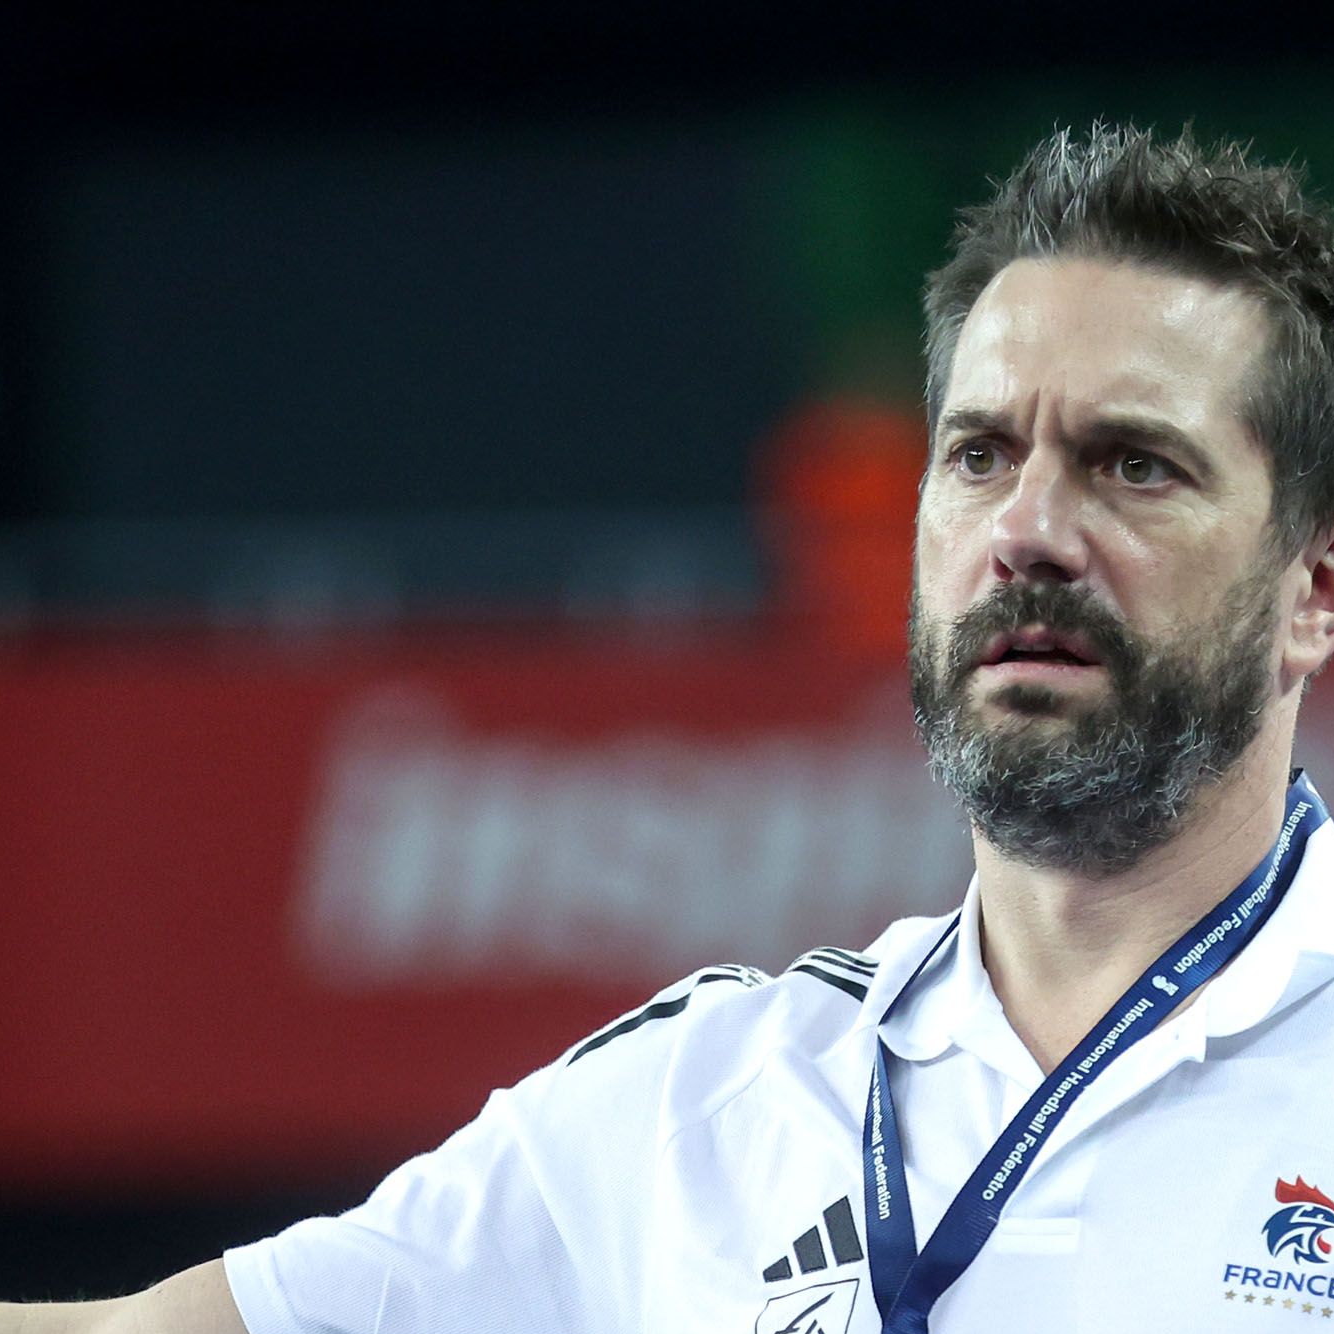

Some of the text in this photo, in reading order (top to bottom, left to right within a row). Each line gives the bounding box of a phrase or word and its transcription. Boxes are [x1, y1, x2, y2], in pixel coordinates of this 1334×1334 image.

[1173, 912, 1242, 974] Federation
[1077, 998, 1154, 1073] International
[1028, 1071, 1083, 1134] Handball
[872, 1145, 891, 1219] Federation
